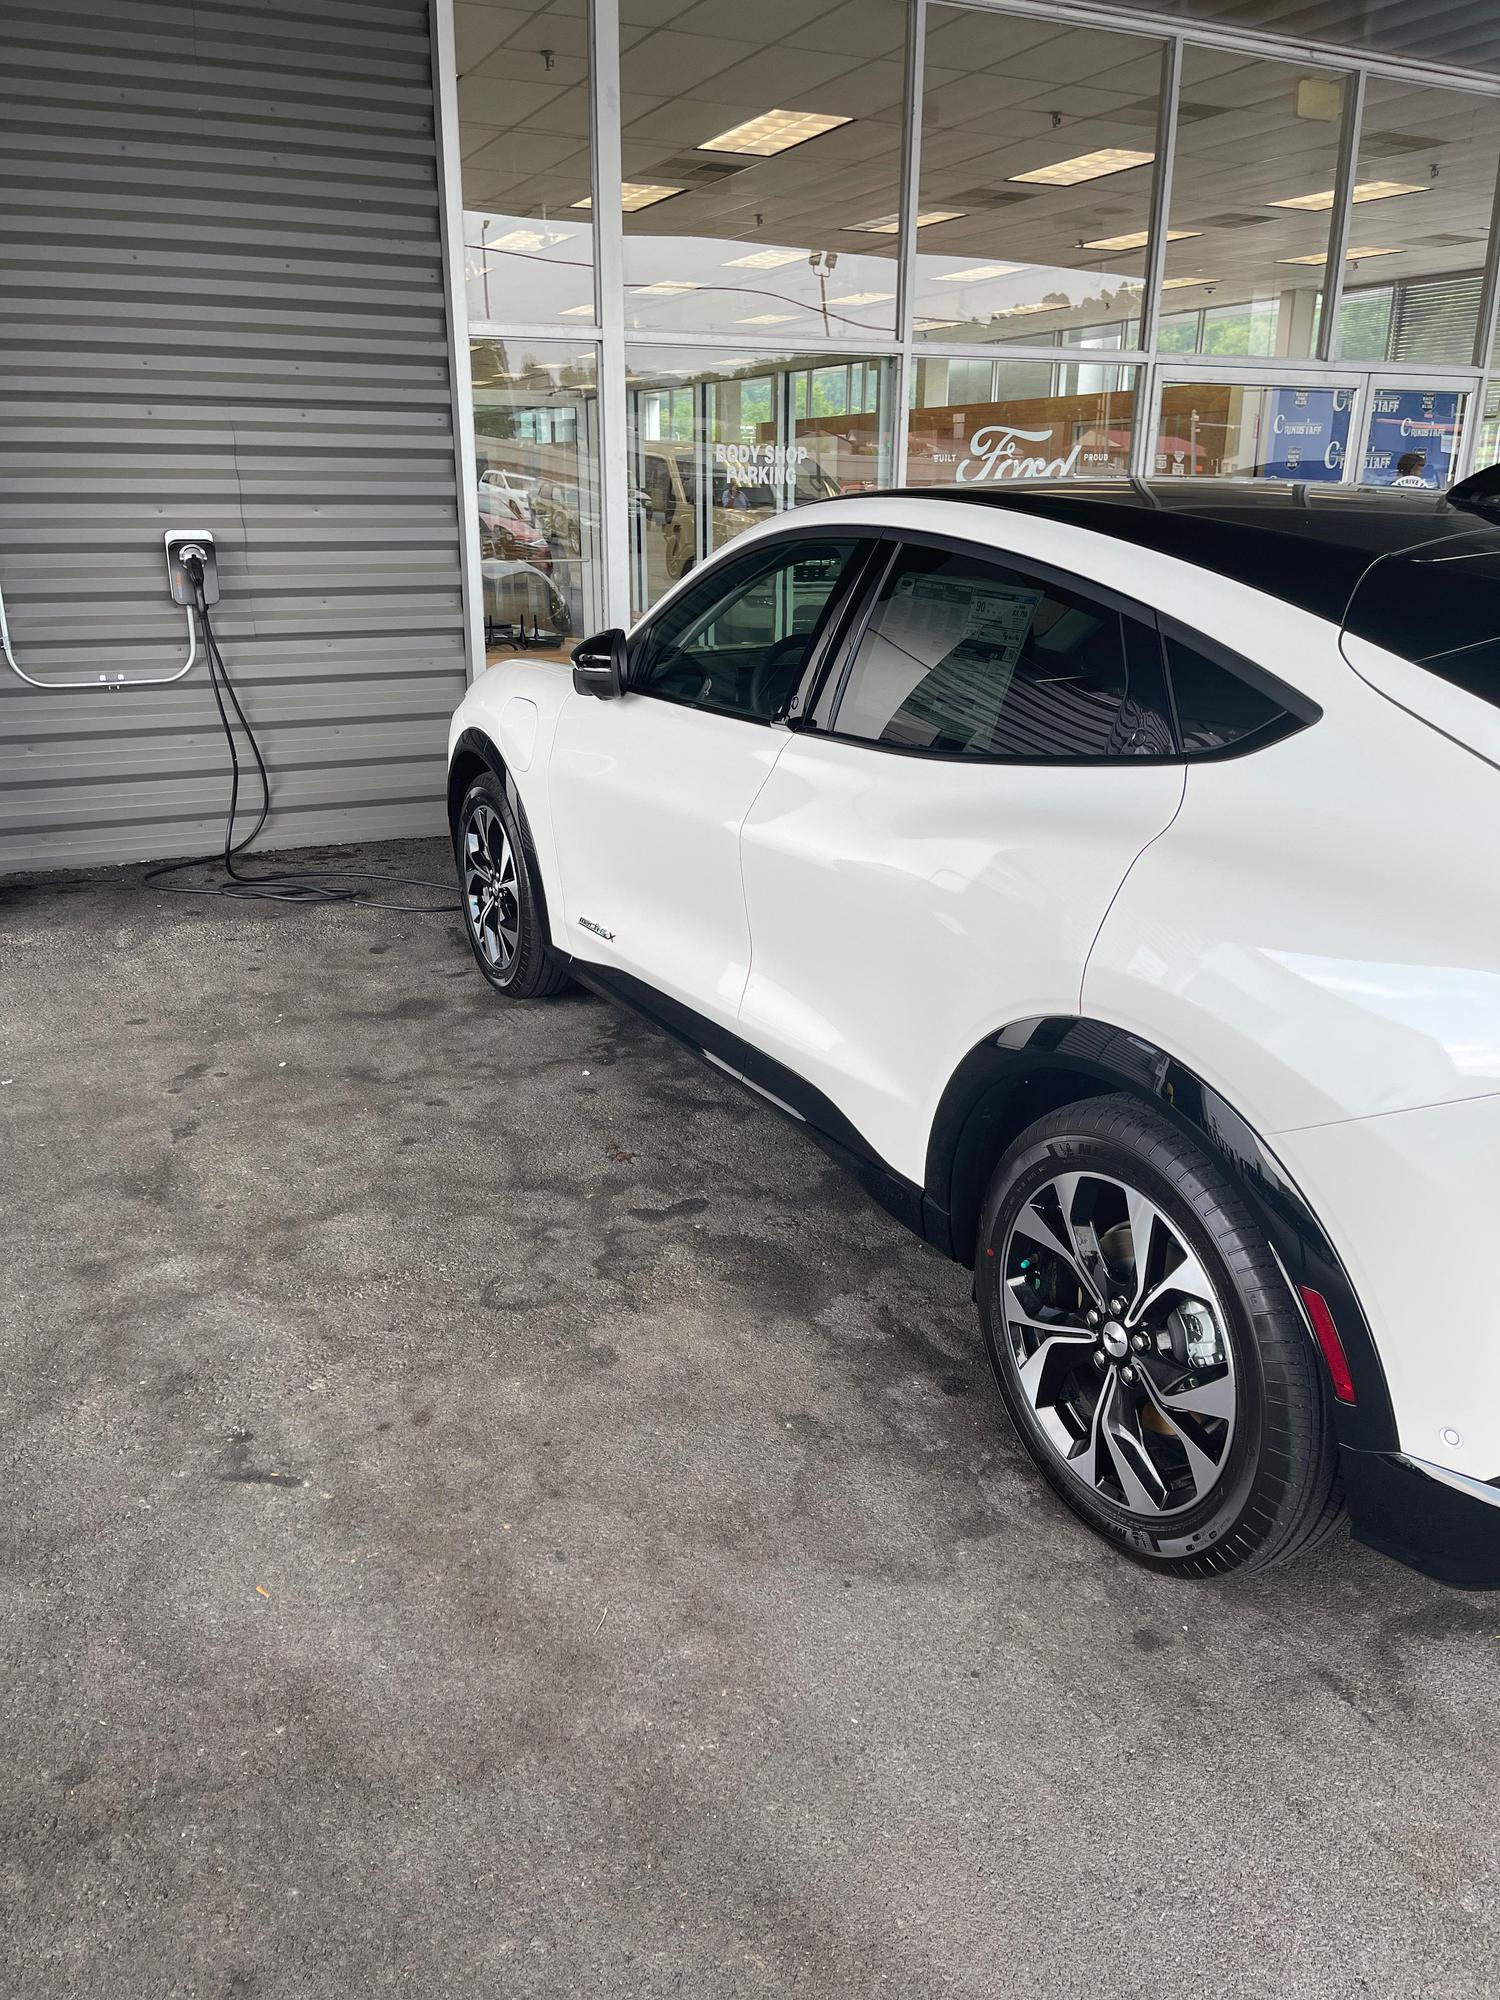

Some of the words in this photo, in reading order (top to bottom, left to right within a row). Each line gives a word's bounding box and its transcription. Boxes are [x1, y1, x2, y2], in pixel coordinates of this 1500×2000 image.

[716, 444, 760, 463] BODY
[764, 444, 807, 464] SHOP
[933, 454, 957, 463] BUILT
[955, 425, 1082, 482] Ford
[1083, 453, 1109, 461] PROUD
[726, 466, 796, 485] PARKING
